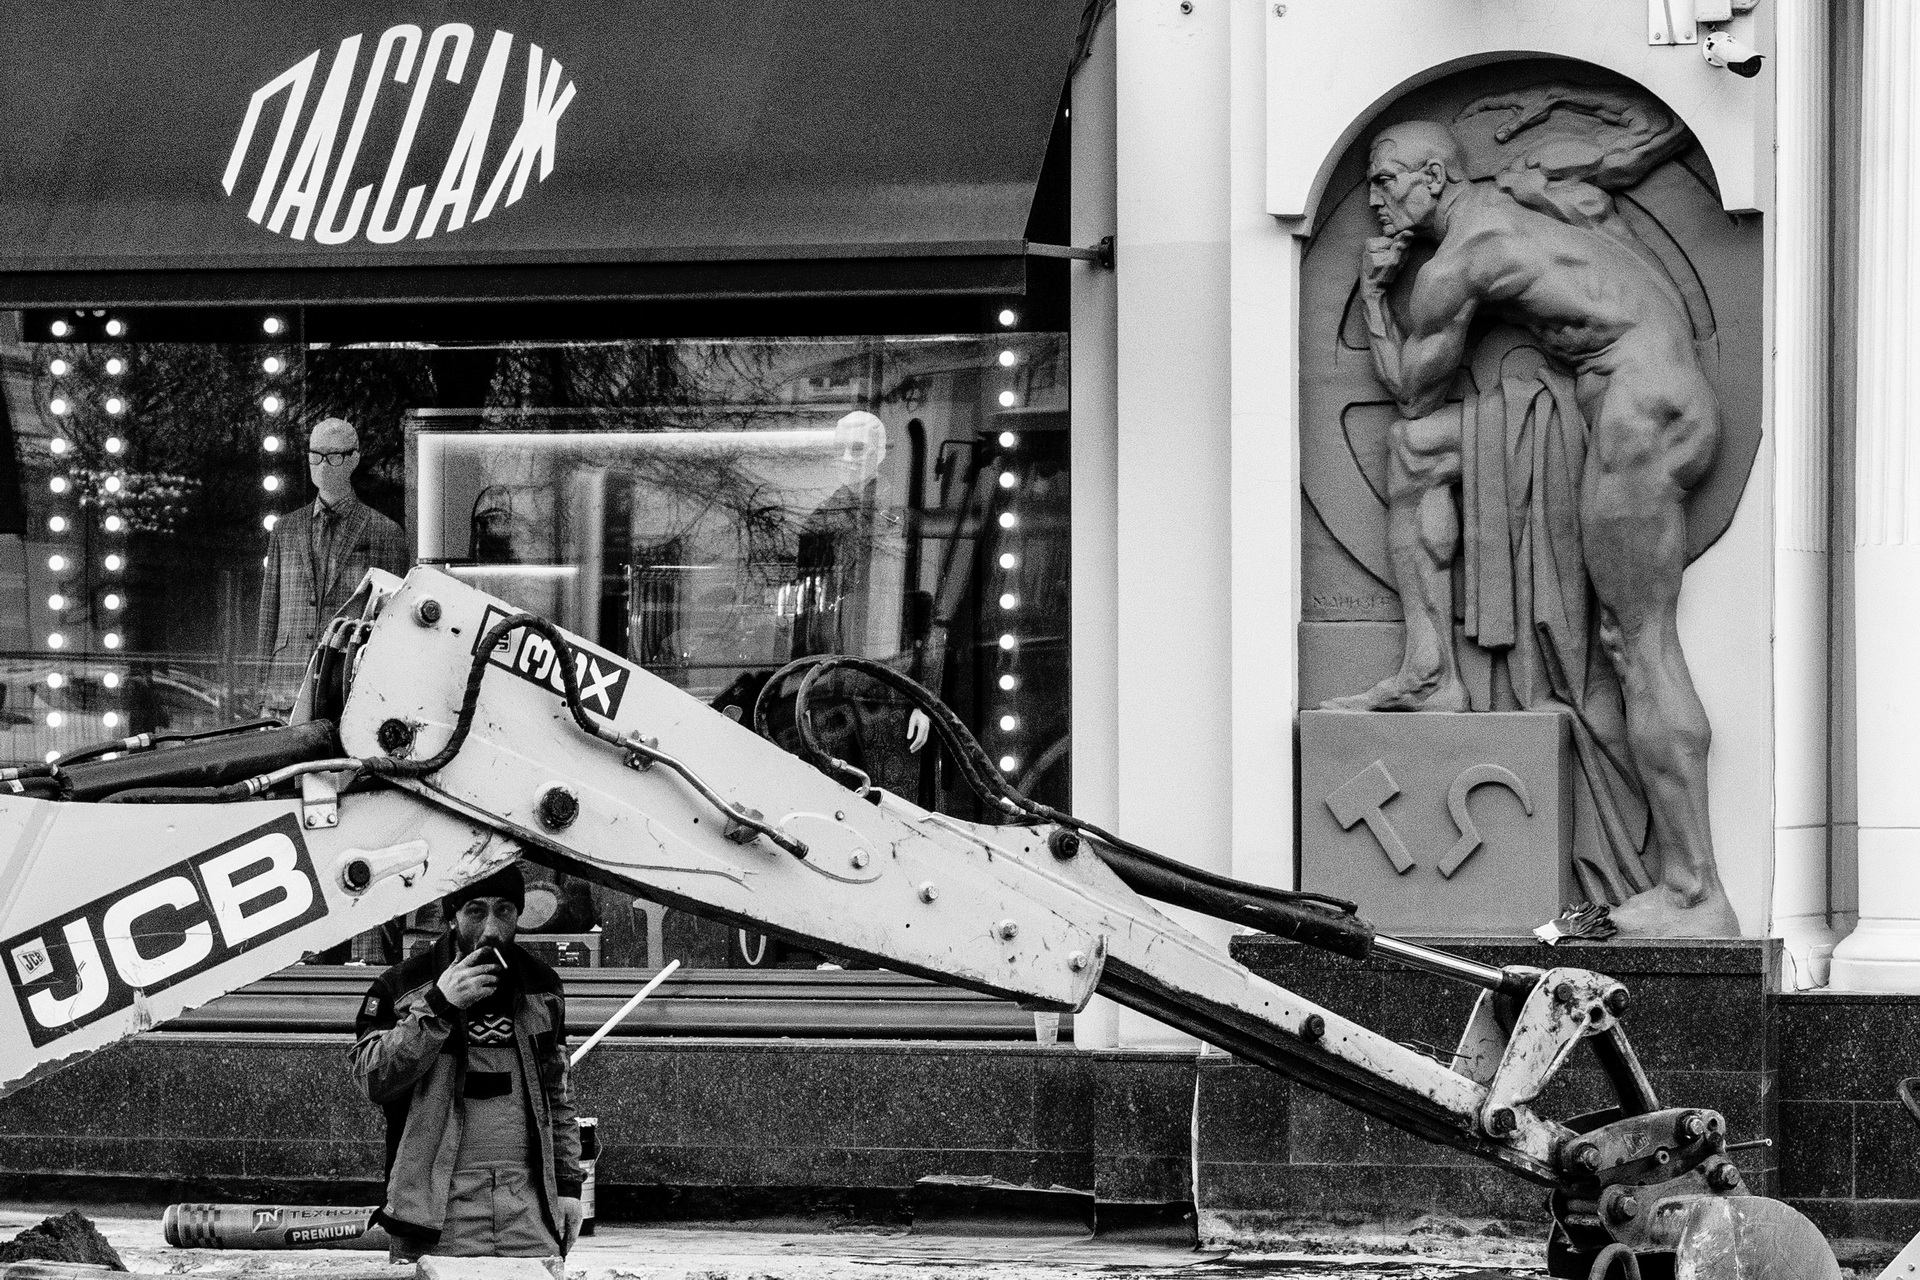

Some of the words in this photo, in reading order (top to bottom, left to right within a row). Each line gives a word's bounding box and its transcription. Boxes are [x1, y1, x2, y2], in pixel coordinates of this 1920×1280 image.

[222, 23, 577, 245] ПАССАЖ
[21, 951, 45, 971] JCB
[27, 832, 314, 1028] JCB
[292, 1224, 356, 1242] PREMIUM
